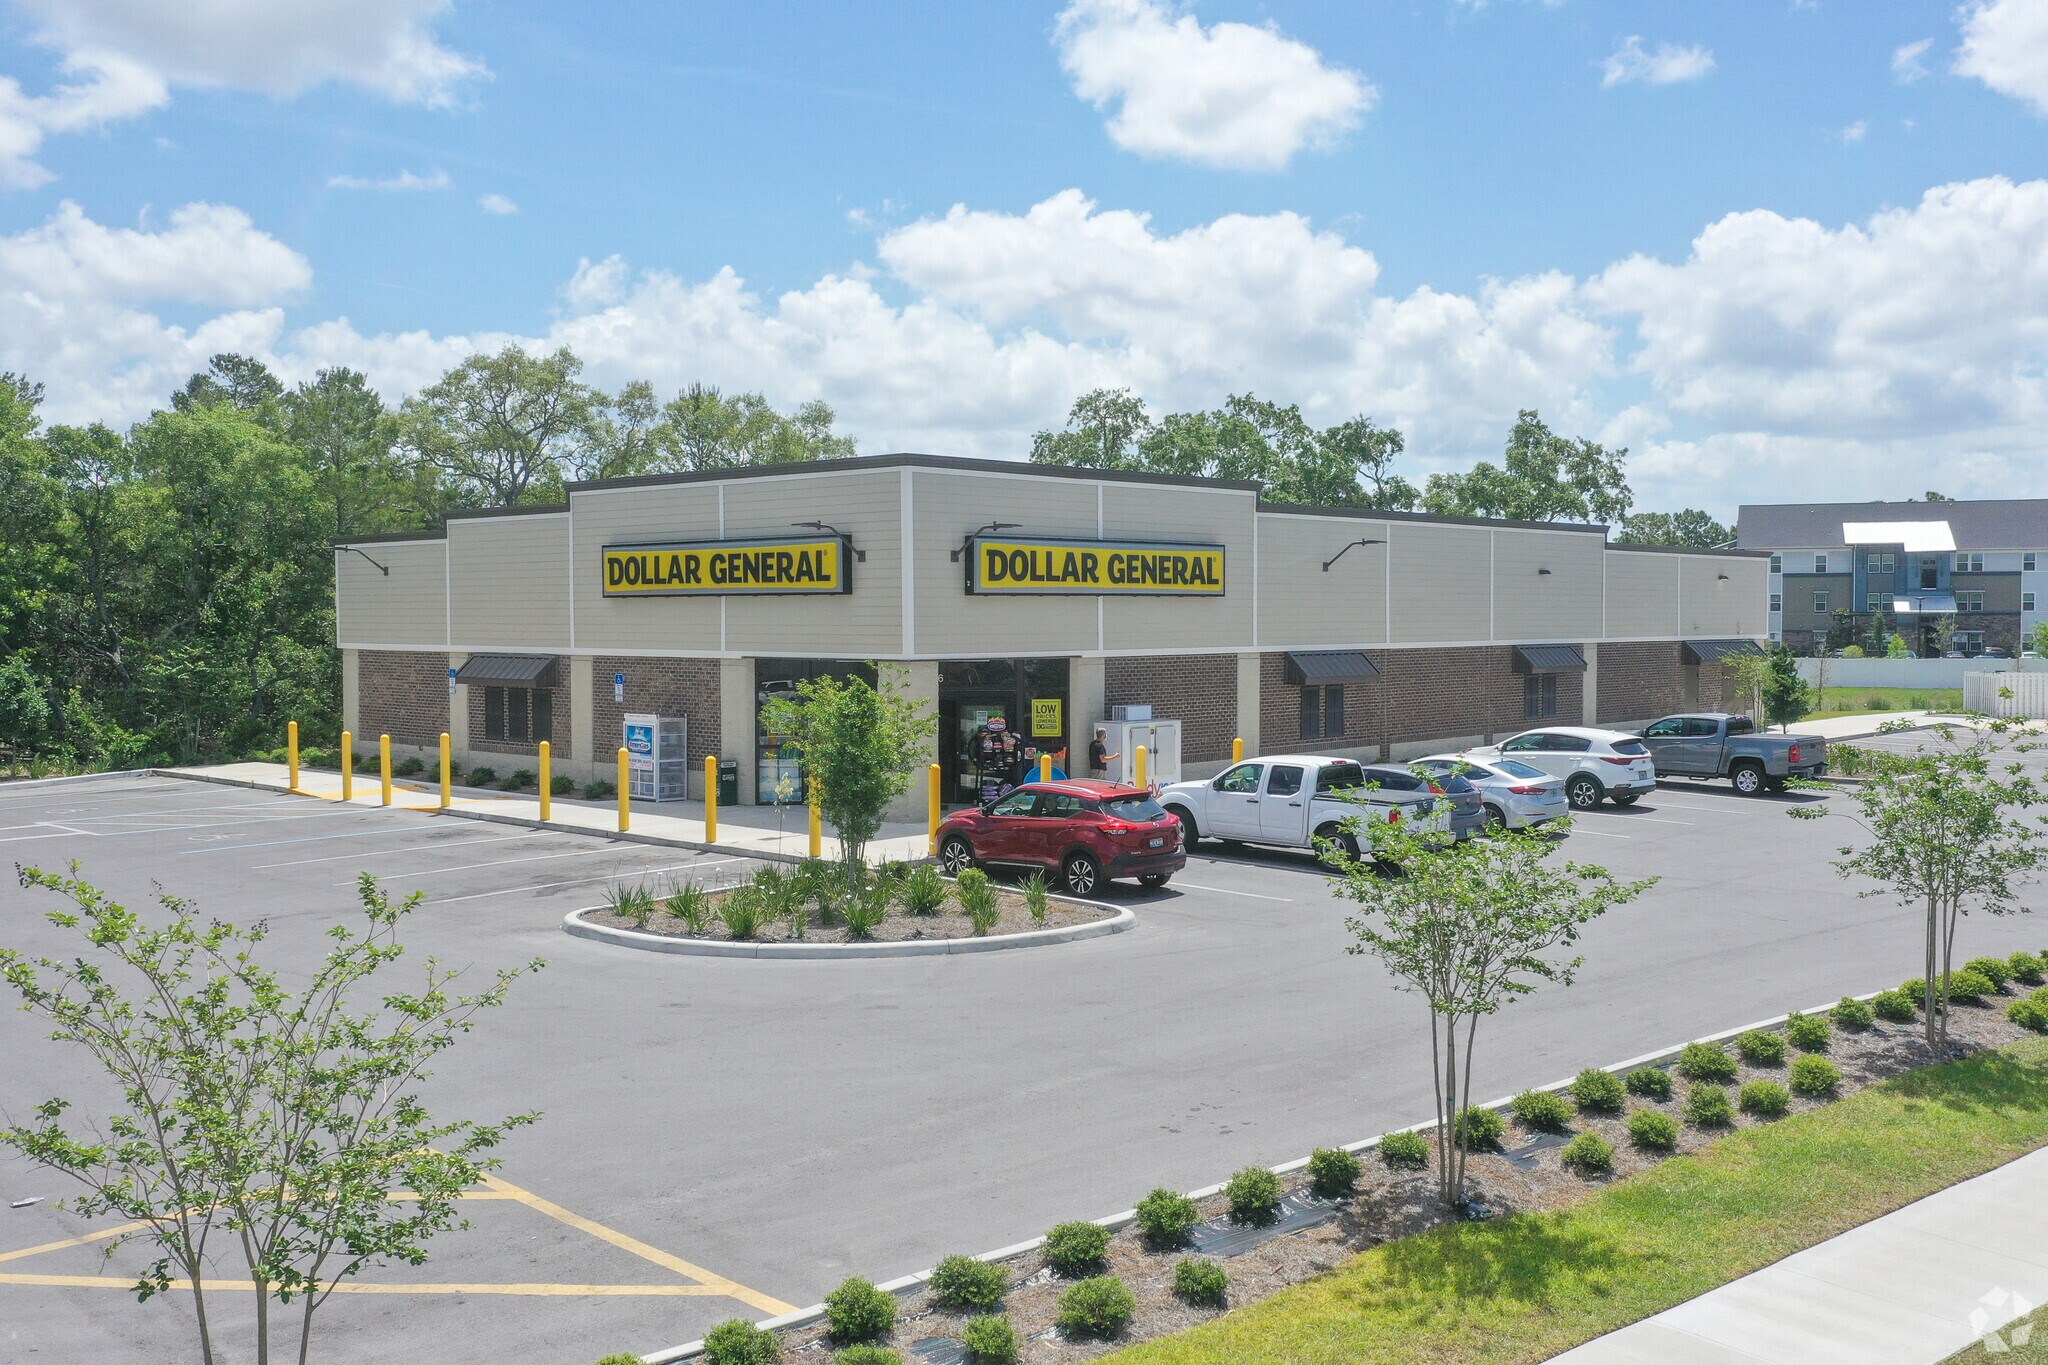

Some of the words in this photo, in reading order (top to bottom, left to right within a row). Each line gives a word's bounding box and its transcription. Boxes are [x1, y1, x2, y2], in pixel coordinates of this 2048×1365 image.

[608, 555, 701, 586] DOLLAR
[709, 550, 831, 584] GENERAL
[986, 549, 1100, 583] DOLLAR
[1107, 553, 1220, 585] GENERAL
[1036, 704, 1056, 714] LOW
